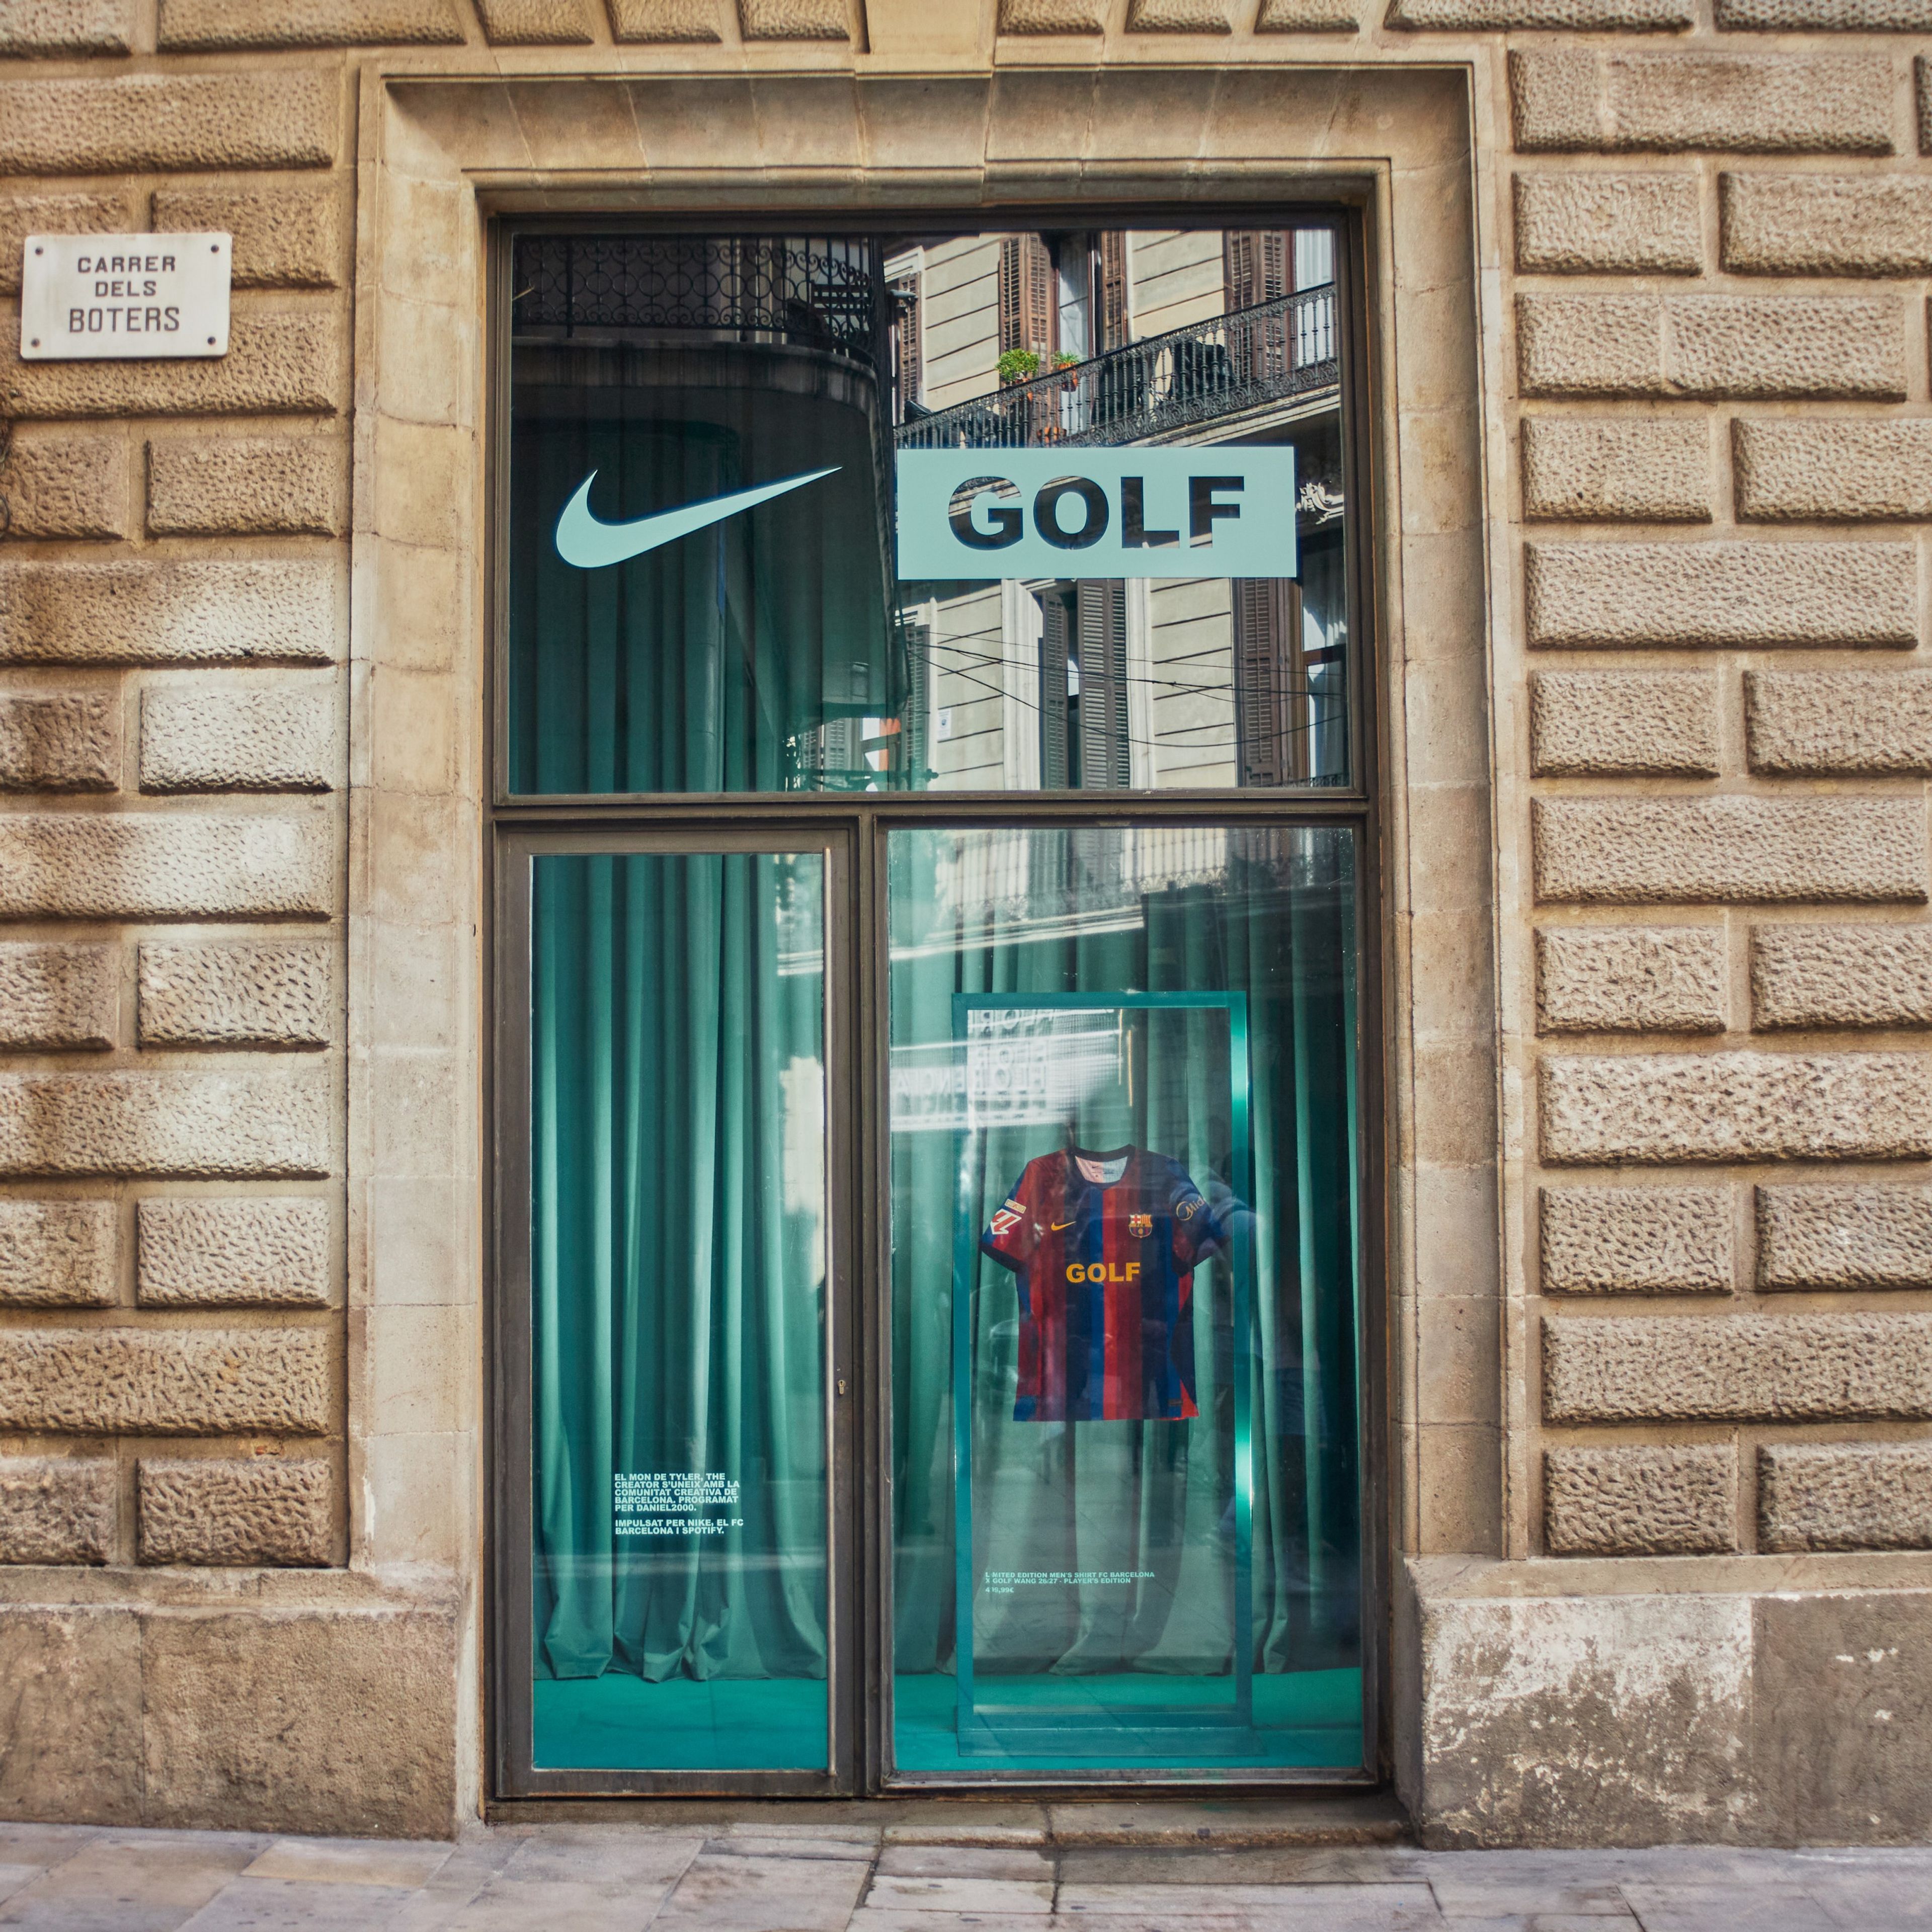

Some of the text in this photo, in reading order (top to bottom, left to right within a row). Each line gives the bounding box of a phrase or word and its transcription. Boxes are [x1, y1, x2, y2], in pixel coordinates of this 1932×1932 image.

[77, 256, 176, 273] CARRER
[95, 281, 156, 297] DELS
[69, 307, 180, 333] BOTERS
[948, 475, 1245, 550] GOLF
[1066, 1262, 1141, 1282] GOLF
[669, 1473, 703, 1482] TYLER,
[687, 1519, 714, 1527] NIKE,
